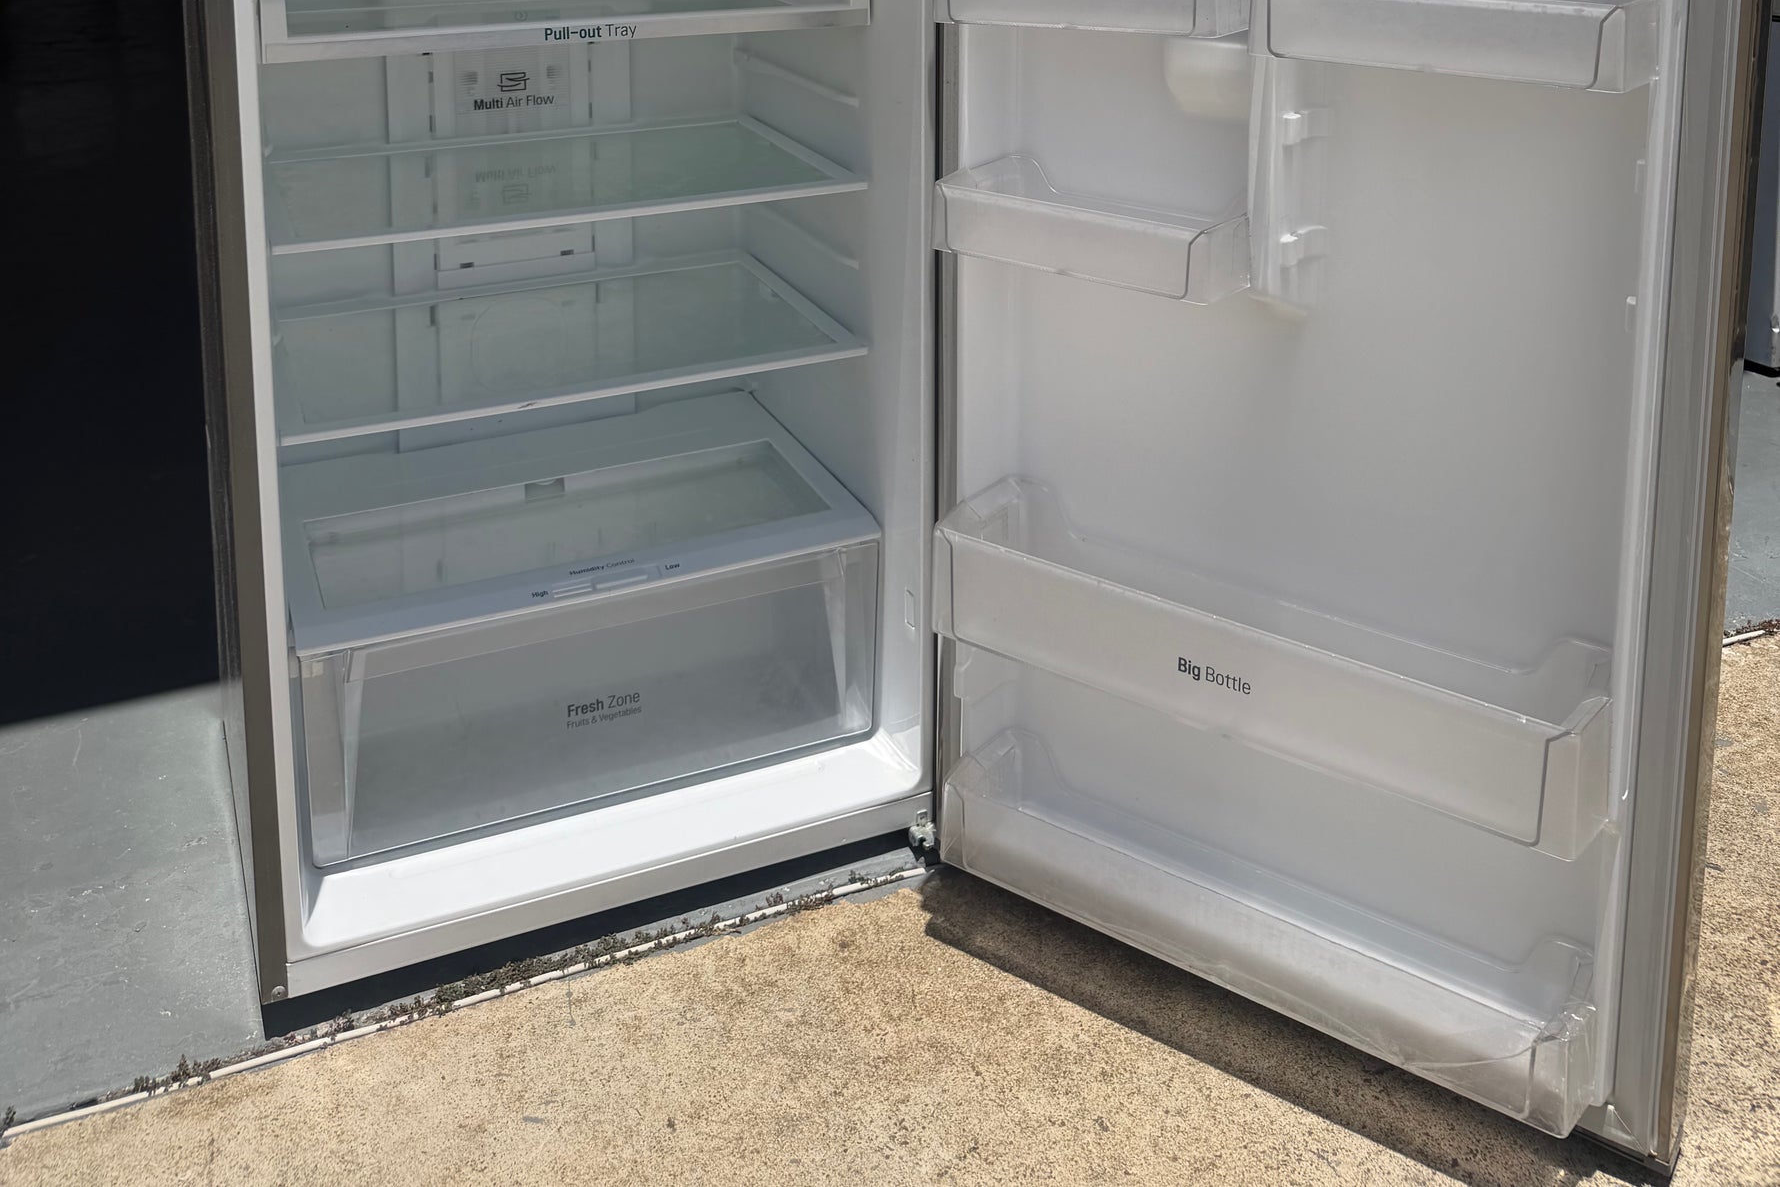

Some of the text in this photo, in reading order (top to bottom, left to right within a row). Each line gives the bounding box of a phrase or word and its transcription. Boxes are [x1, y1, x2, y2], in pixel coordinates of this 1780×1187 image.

[544, 23, 637, 41] Pull-out Tray
[473, 95, 554, 111] Multi Air Flow
[569, 558, 635, 576] Humidity Control
[665, 563, 680, 571] Low
[531, 590, 549, 599] High
[1177, 656, 1251, 695] Big Bottle
[567, 692, 640, 718] Fresh Zone
[566, 706, 642, 729] Fruits & Vegetables
